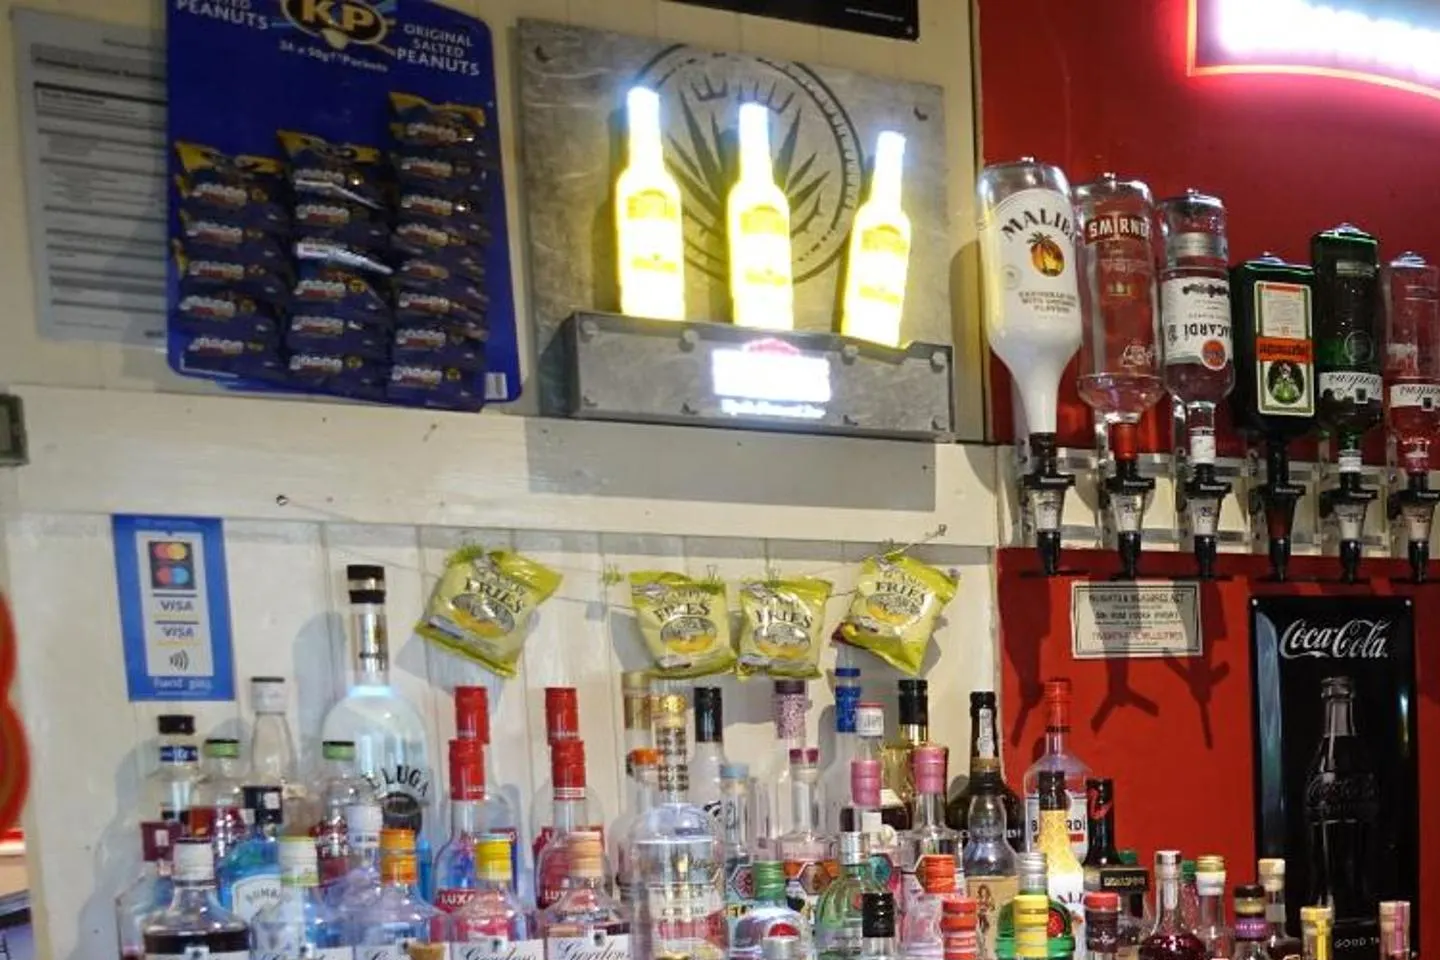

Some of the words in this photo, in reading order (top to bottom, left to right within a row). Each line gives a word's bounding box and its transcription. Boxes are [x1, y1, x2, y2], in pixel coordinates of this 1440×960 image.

[301, 0, 373, 29] KP
[403, 22, 475, 47] ORIGINAL
[412, 37, 465, 58] SALTED
[396, 47, 480, 77] PEANUTS
[875, 579, 927, 604] FRIES
[159, 600, 195, 612] VISA
[651, 601, 712, 624] FRIES
[754, 607, 814, 631] FRIES
[162, 626, 196, 638] VISA
[1279, 617, 1394, 660] Coca-Cola
